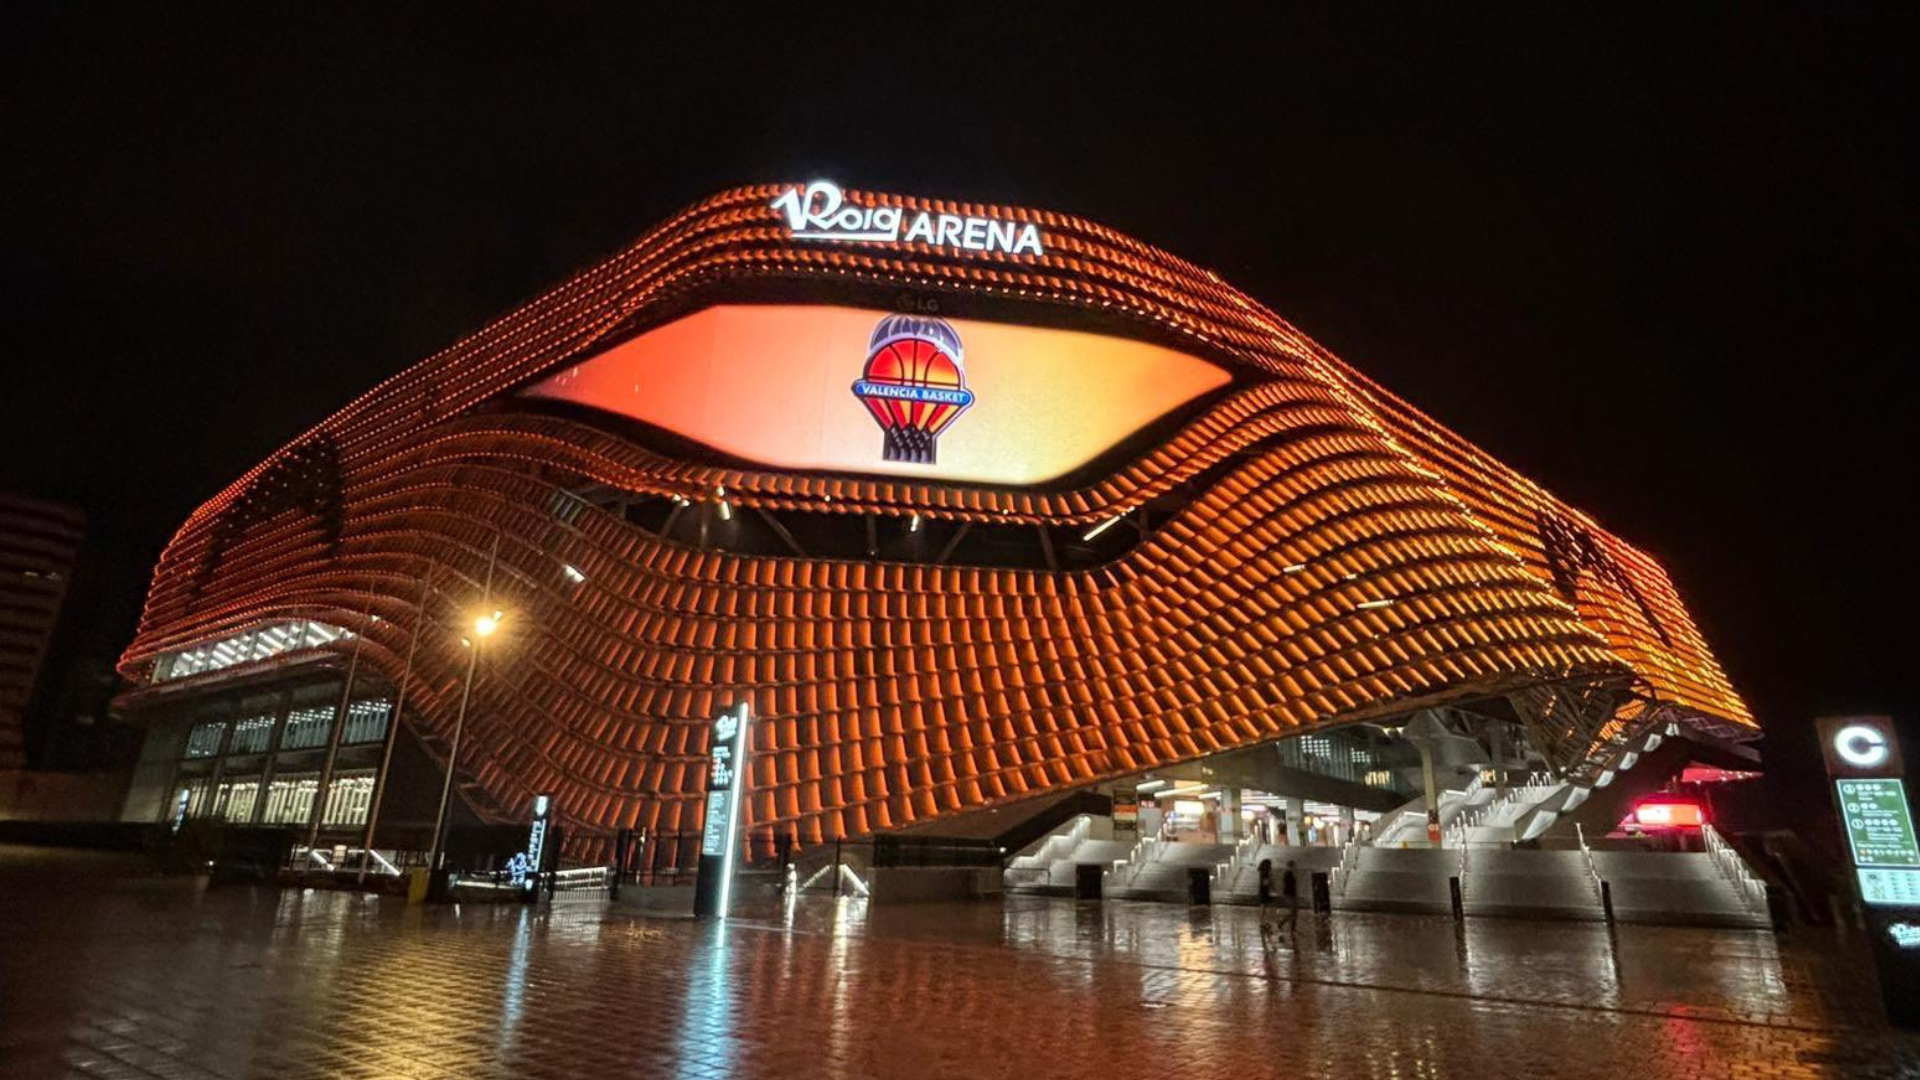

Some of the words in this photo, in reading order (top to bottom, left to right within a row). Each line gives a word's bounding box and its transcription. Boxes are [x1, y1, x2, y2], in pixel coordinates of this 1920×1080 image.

[770, 182, 902, 241] Roig
[904, 213, 1043, 256] ARENA
[917, 300, 939, 311] LG
[862, 384, 918, 398] VALENCIA
[921, 388, 965, 403] BASKET
